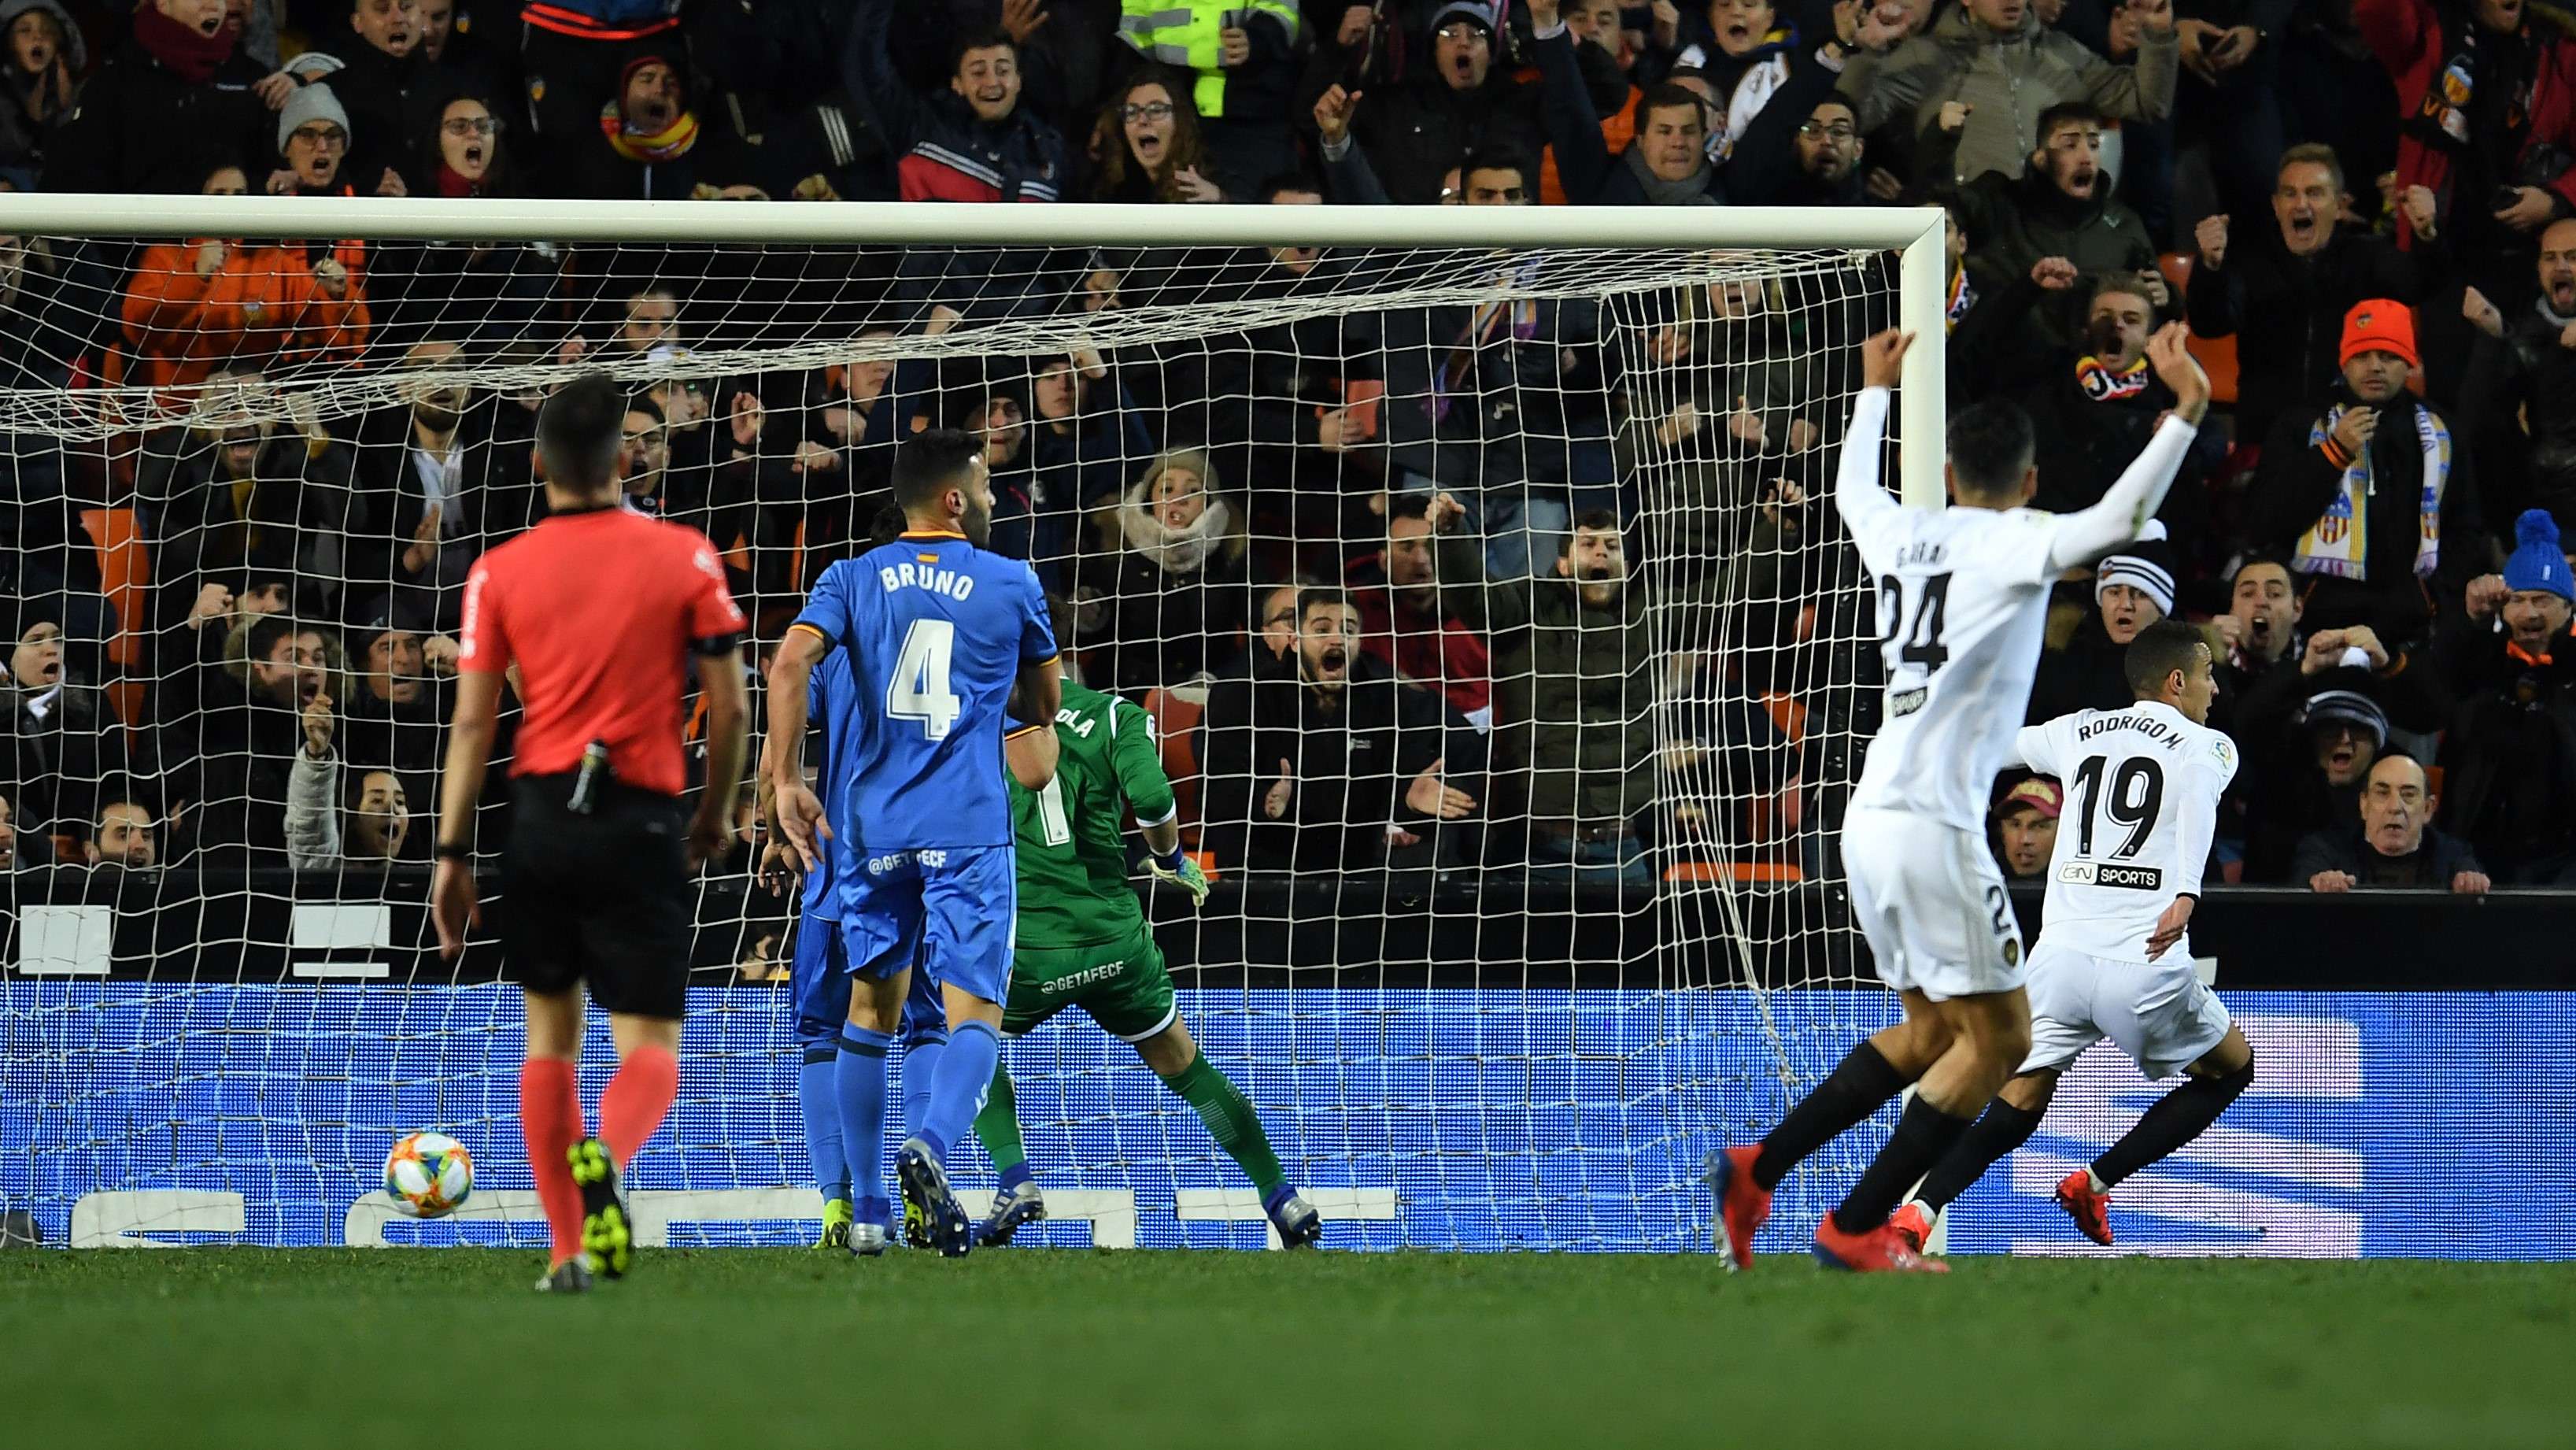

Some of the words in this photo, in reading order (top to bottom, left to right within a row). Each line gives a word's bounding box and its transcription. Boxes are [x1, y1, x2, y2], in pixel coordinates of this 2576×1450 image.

[880, 563, 974, 601] BRUNO
[886, 619, 960, 741] 4
[2079, 716, 2167, 742] RODRIGO
[2072, 755, 2164, 861] 19
[2100, 867, 2157, 886] SPORTS
[1040, 960, 1125, 995] @GETAFECF
